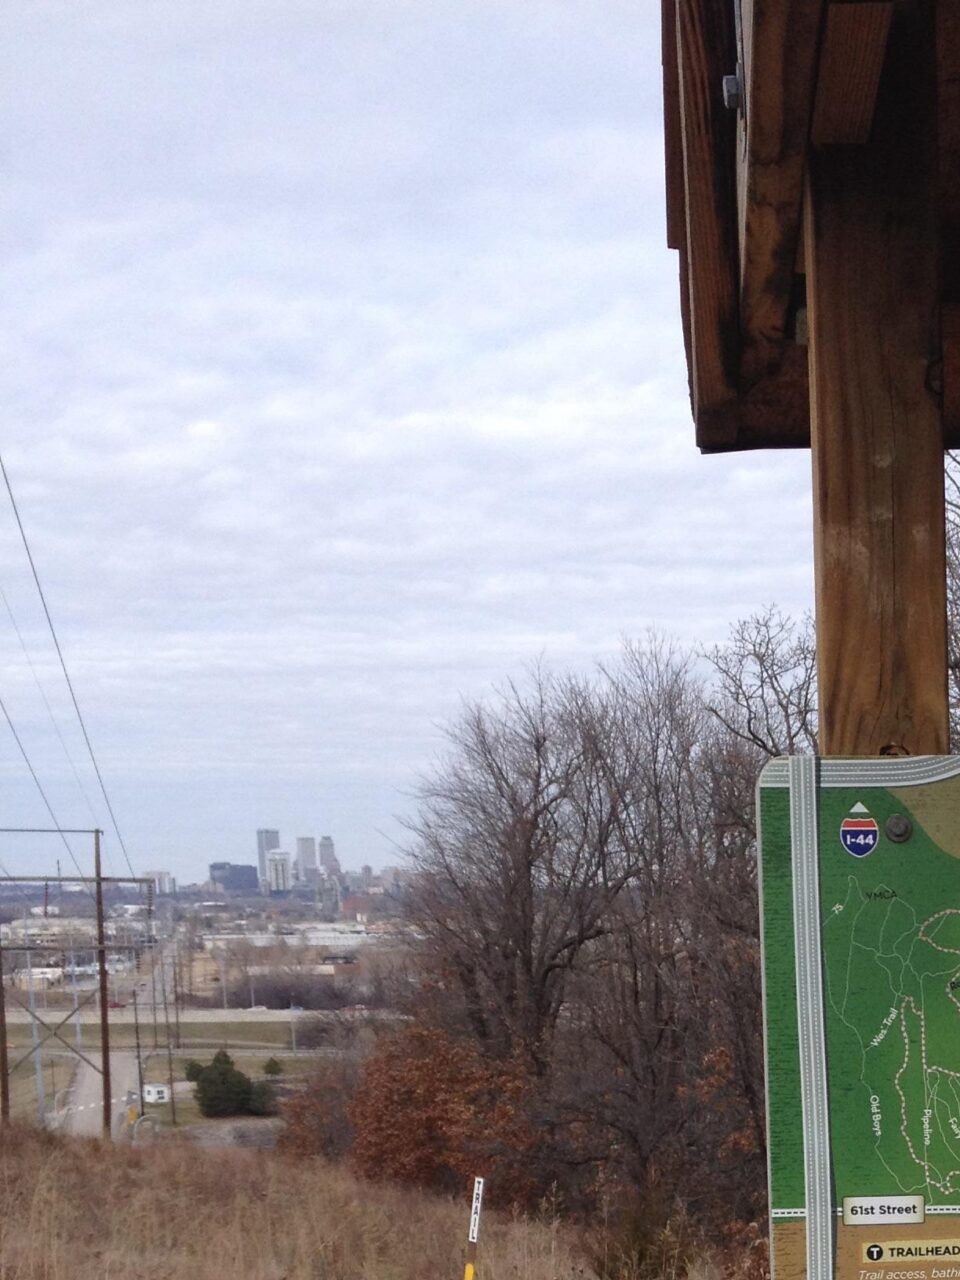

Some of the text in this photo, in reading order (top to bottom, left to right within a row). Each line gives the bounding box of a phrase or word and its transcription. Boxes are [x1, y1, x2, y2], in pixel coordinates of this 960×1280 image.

[846, 834, 874, 846] I-44
[831, 902, 844, 915] 75
[923, 1108, 933, 1146] Pipeline
[472, 1180, 482, 1240] TRAIL
[850, 1204, 918, 1216] 61st Street
[859, 1269, 885, 1280] Trail
[886, 1270, 928, 1280] access,
